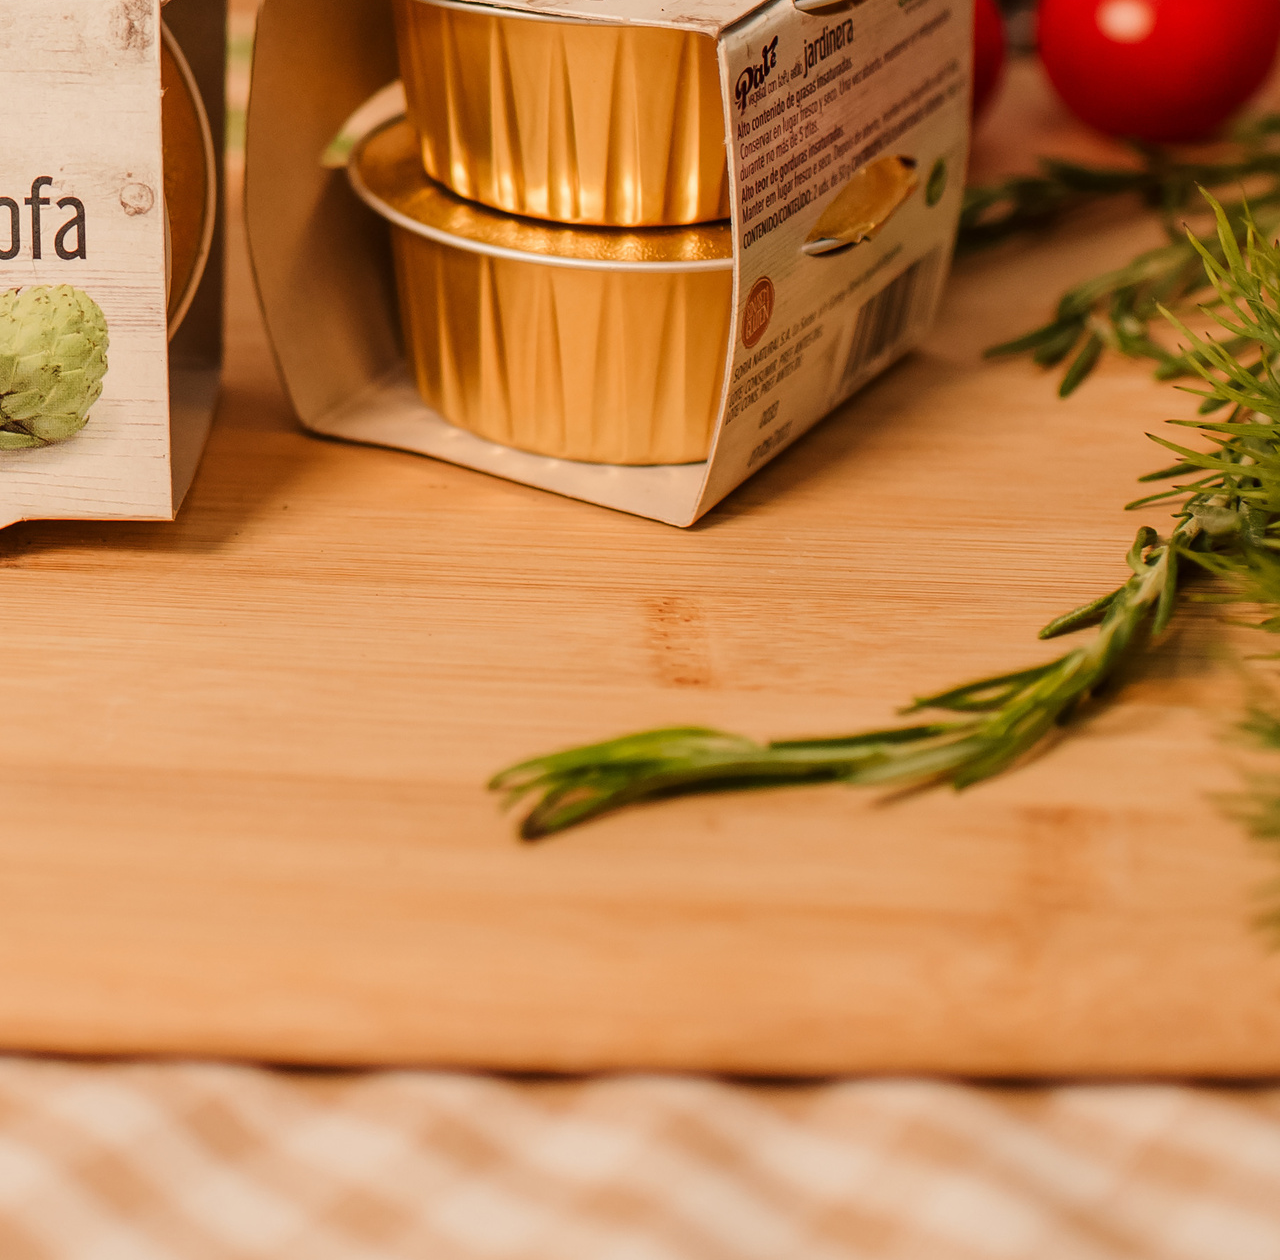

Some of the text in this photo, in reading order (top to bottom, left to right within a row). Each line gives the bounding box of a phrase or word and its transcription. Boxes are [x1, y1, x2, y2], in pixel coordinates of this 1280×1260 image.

[734, 35, 779, 112] Paté
[802, 18, 854, 80] jardinera
[737, 121, 751, 142] Alto
[751, 97, 786, 132] contenido
[786, 92, 795, 110] de
[795, 80, 817, 108] grasas
[739, 131, 773, 161] Conservar
[772, 124, 782, 140] en
[782, 112, 799, 134] lugar
[739, 156, 766, 182] durante
[765, 149, 775, 165] no
[789, 131, 799, 149] de
[741, 183, 755, 206] Alto
[754, 174, 769, 195] teor
[769, 166, 779, 186] de
[779, 148, 808, 183] gorduras
[742, 197, 765, 225] Manter
[765, 189, 777, 208] em
[777, 177, 794, 201] lugar
